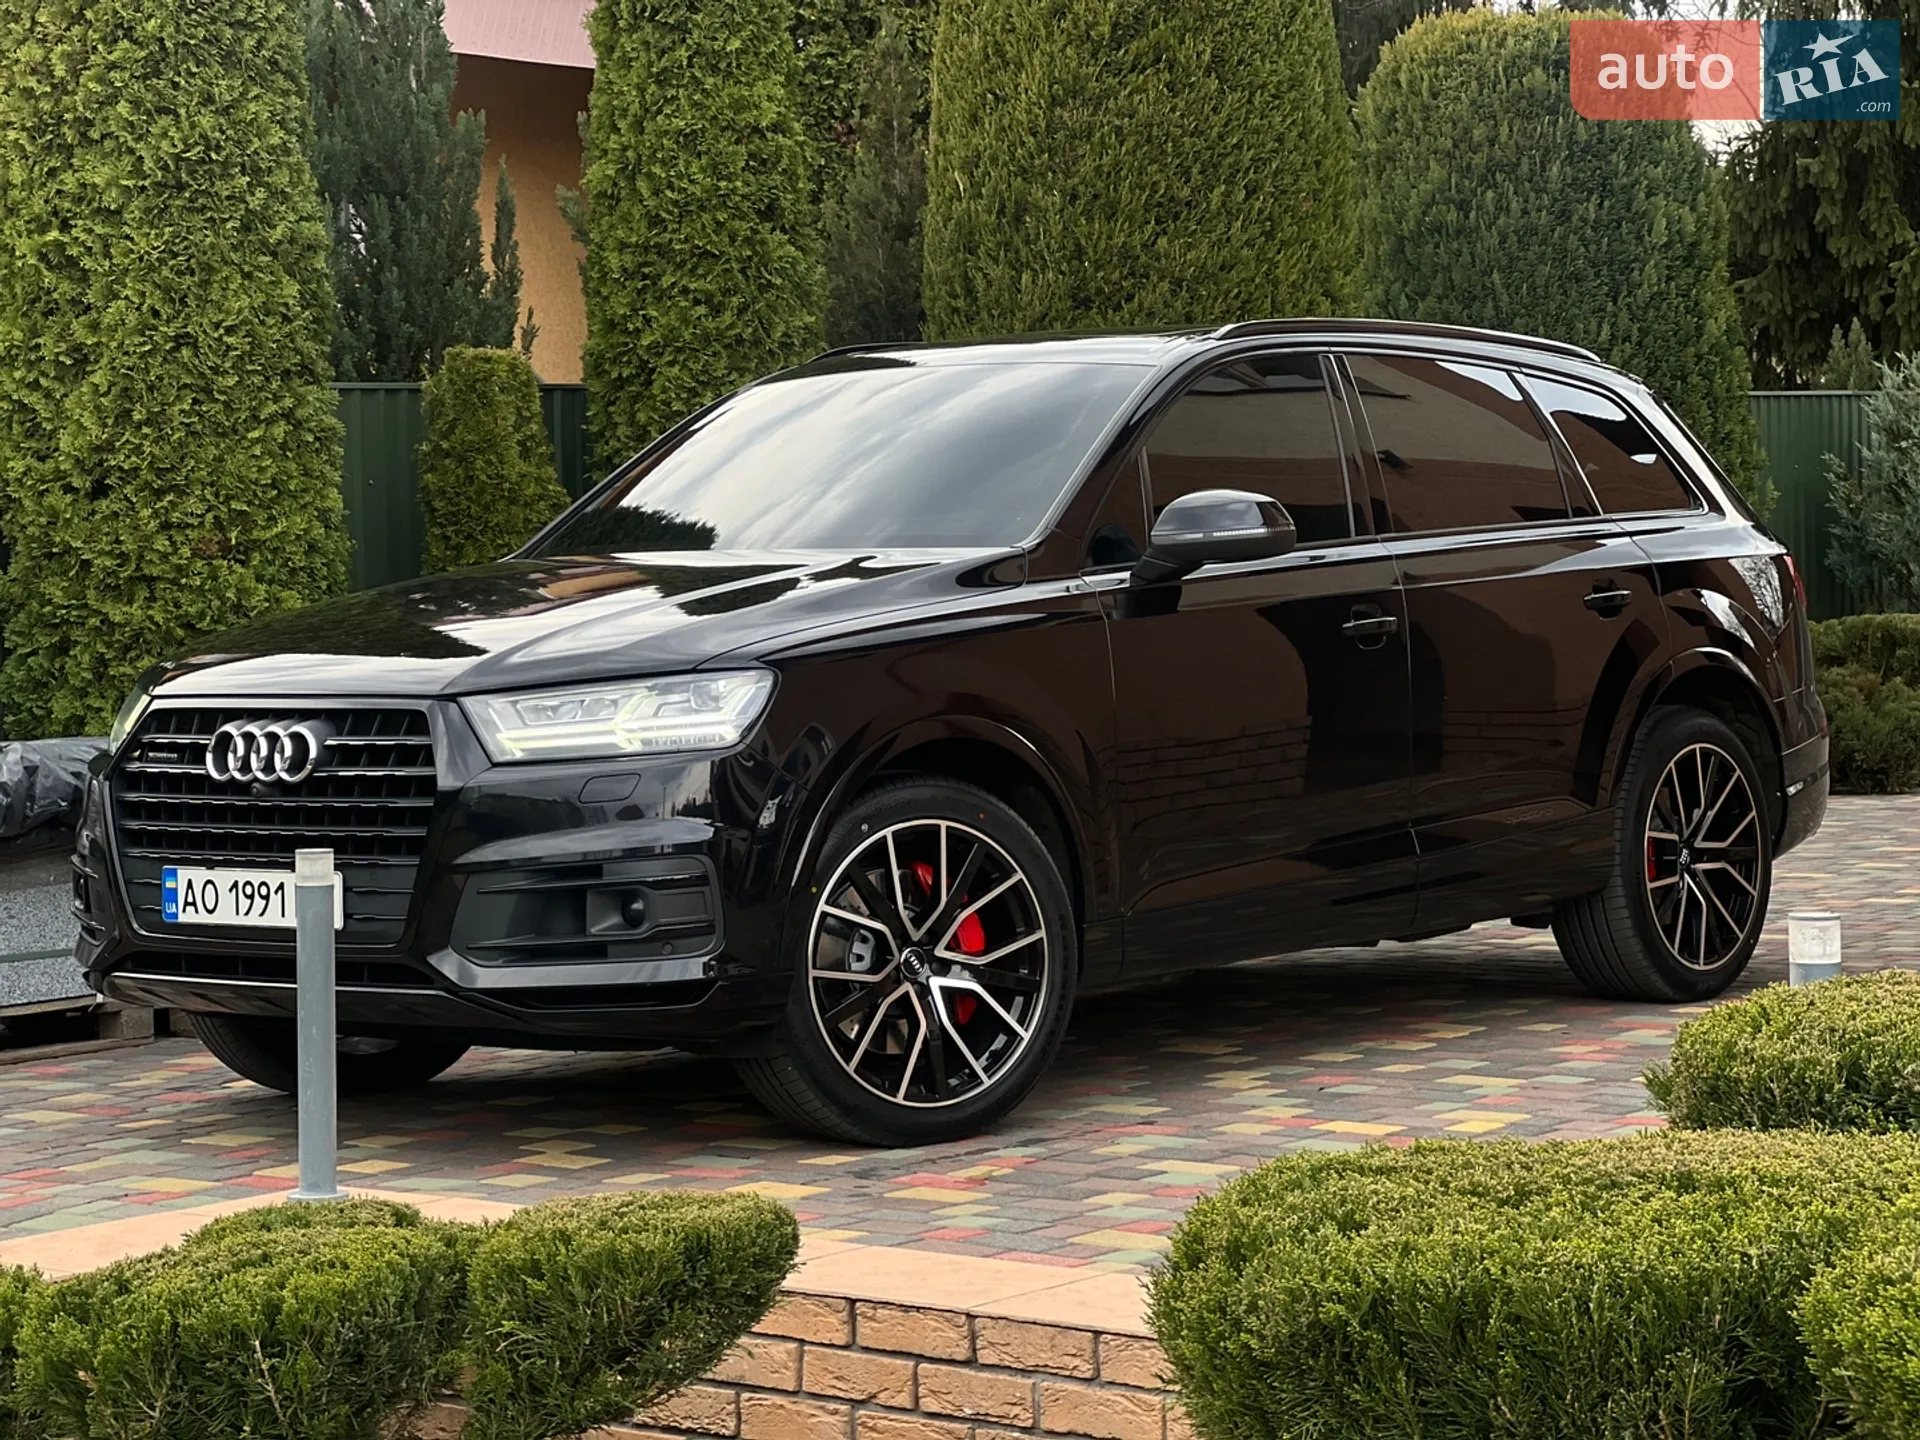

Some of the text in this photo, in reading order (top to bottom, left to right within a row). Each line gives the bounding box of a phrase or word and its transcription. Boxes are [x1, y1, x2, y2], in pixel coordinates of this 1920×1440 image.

[165, 902, 177, 913] UA
[182, 878, 285, 918] AO 1991
